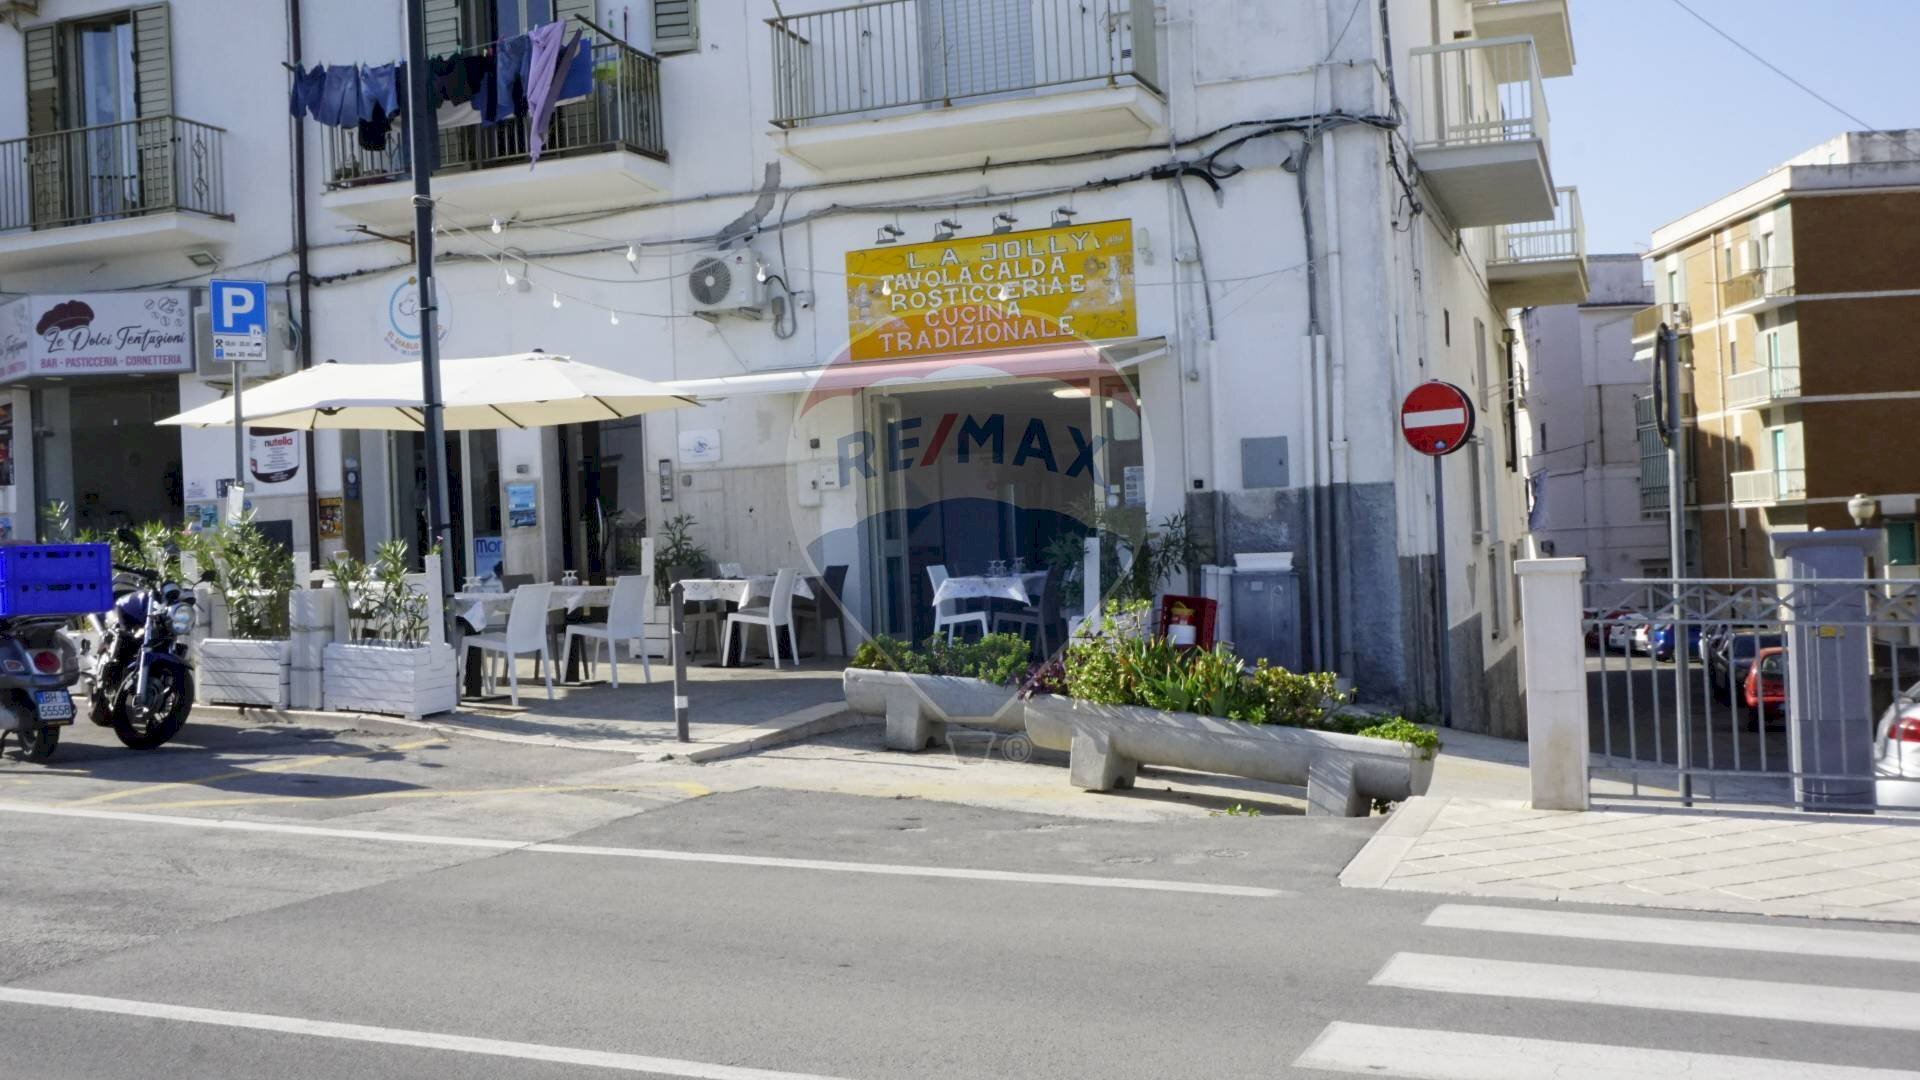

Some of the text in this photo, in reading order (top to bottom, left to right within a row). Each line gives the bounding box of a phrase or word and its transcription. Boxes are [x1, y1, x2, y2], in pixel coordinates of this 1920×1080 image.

[980, 231, 1089, 262] JOLLY
[881, 255, 1066, 292] TAVOLA CALDA
[222, 287, 255, 328] P
[925, 300, 1022, 327] CUCINA
[44, 326, 65, 353] Le
[68, 325, 113, 353] Dolci
[115, 325, 186, 352] Tentazioni
[879, 315, 1074, 353] TRADIZIONALE
[40, 357, 57, 369] BAR
[65, 356, 118, 368] PASTICCERIA
[125, 354, 182, 367] CORNETTERIA
[264, 436, 293, 448] nutella
